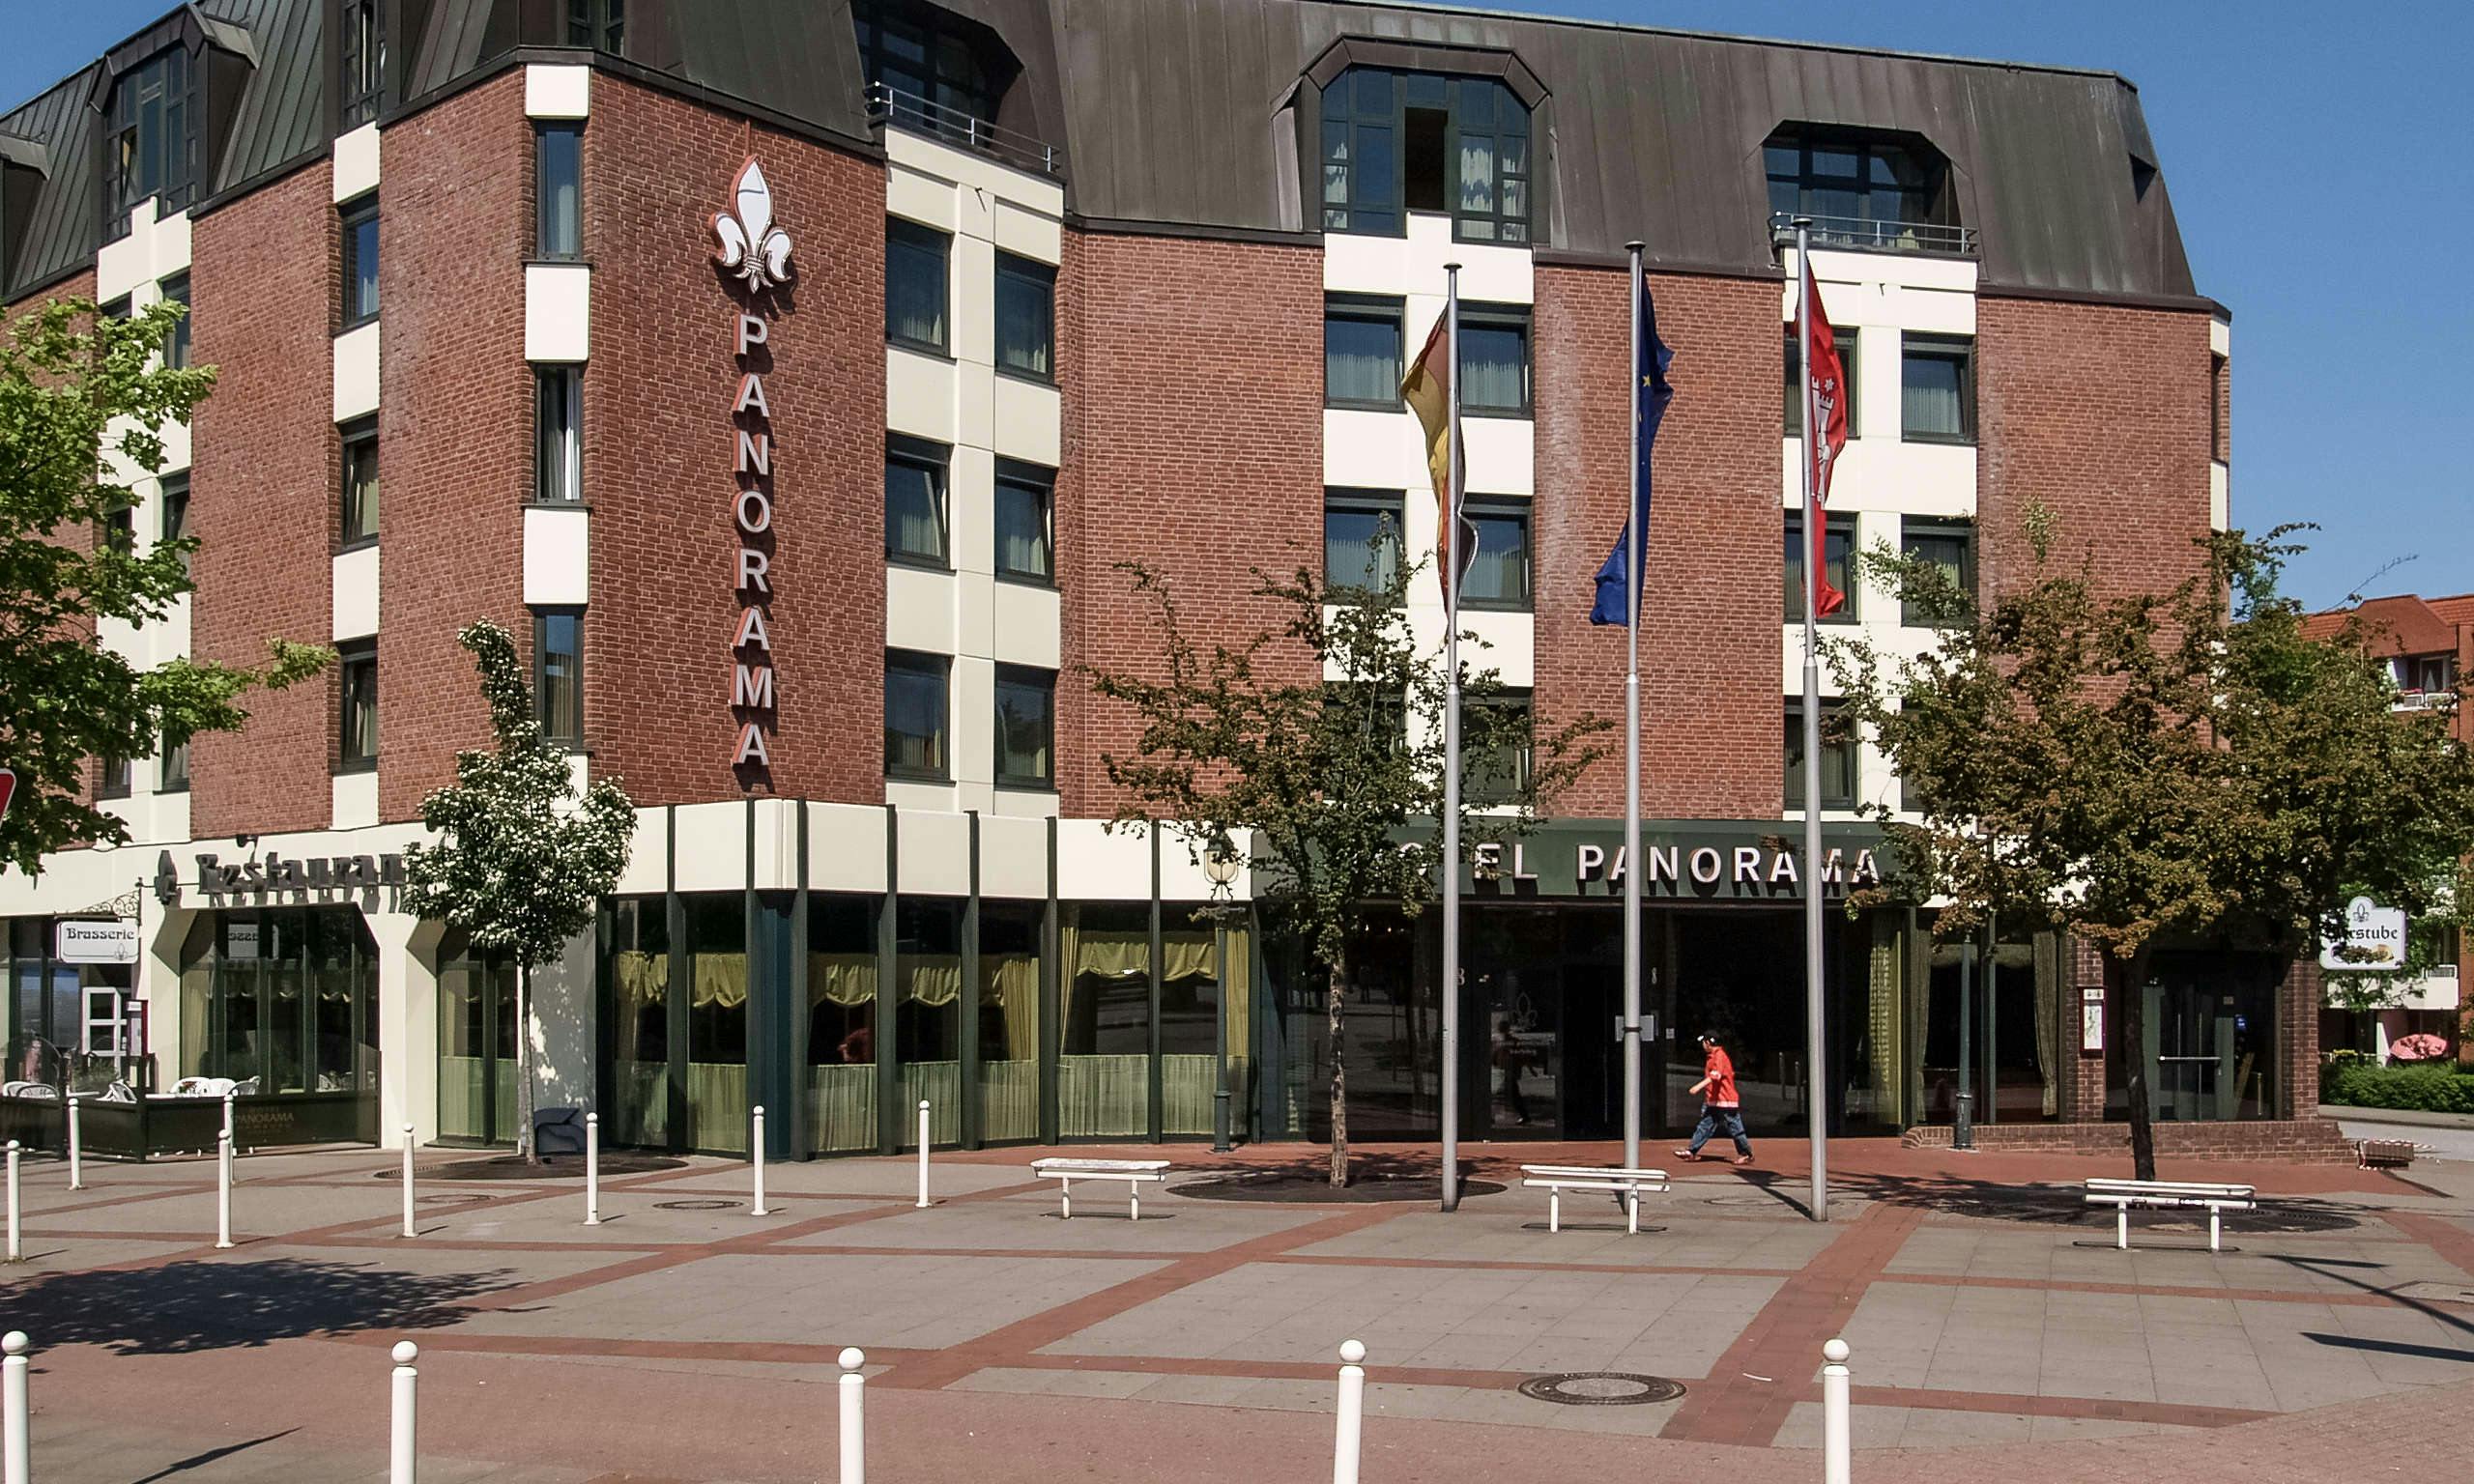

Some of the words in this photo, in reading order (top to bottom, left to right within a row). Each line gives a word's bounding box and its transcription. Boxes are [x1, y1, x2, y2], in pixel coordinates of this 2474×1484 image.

[734, 313, 773, 766] PANORAMA
[195, 844, 422, 895] Restauran
[1577, 843, 1881, 884] PANORAMA
[66, 927, 135, 940] Brasserie
[2326, 925, 2399, 940] rstube
